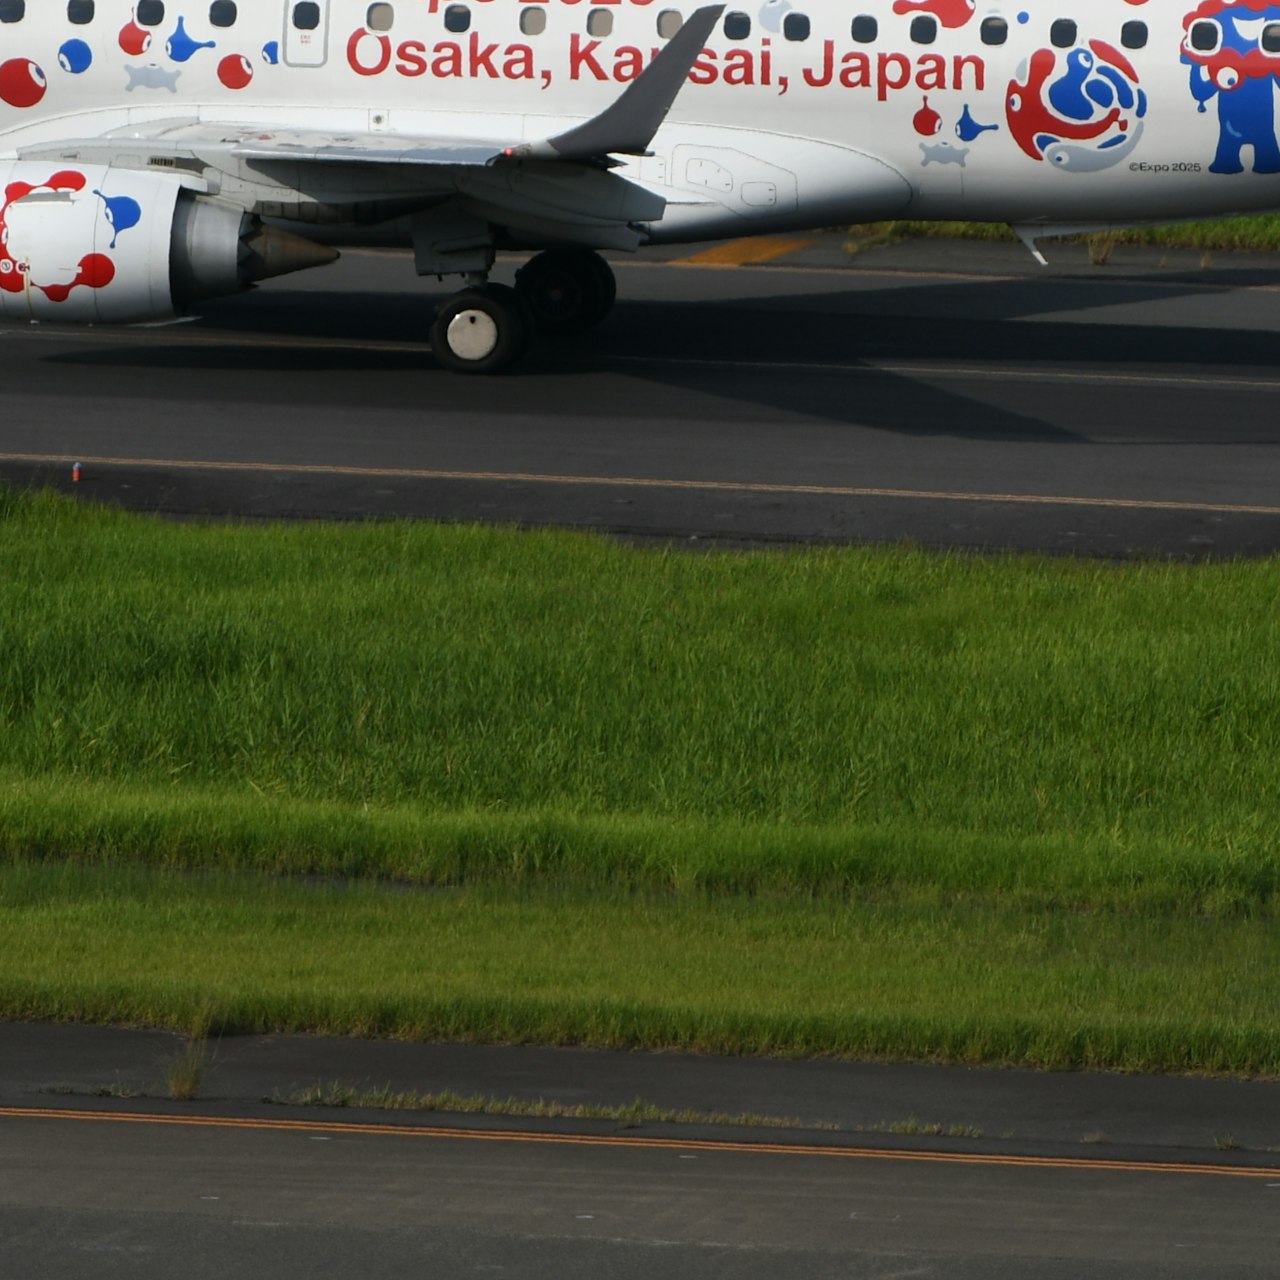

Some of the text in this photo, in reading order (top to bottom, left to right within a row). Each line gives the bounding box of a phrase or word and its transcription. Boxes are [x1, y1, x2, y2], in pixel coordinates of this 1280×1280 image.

[346, 27, 985, 102] Osaka, Kasai, Japan
[1171, 162, 1202, 172] 2025
